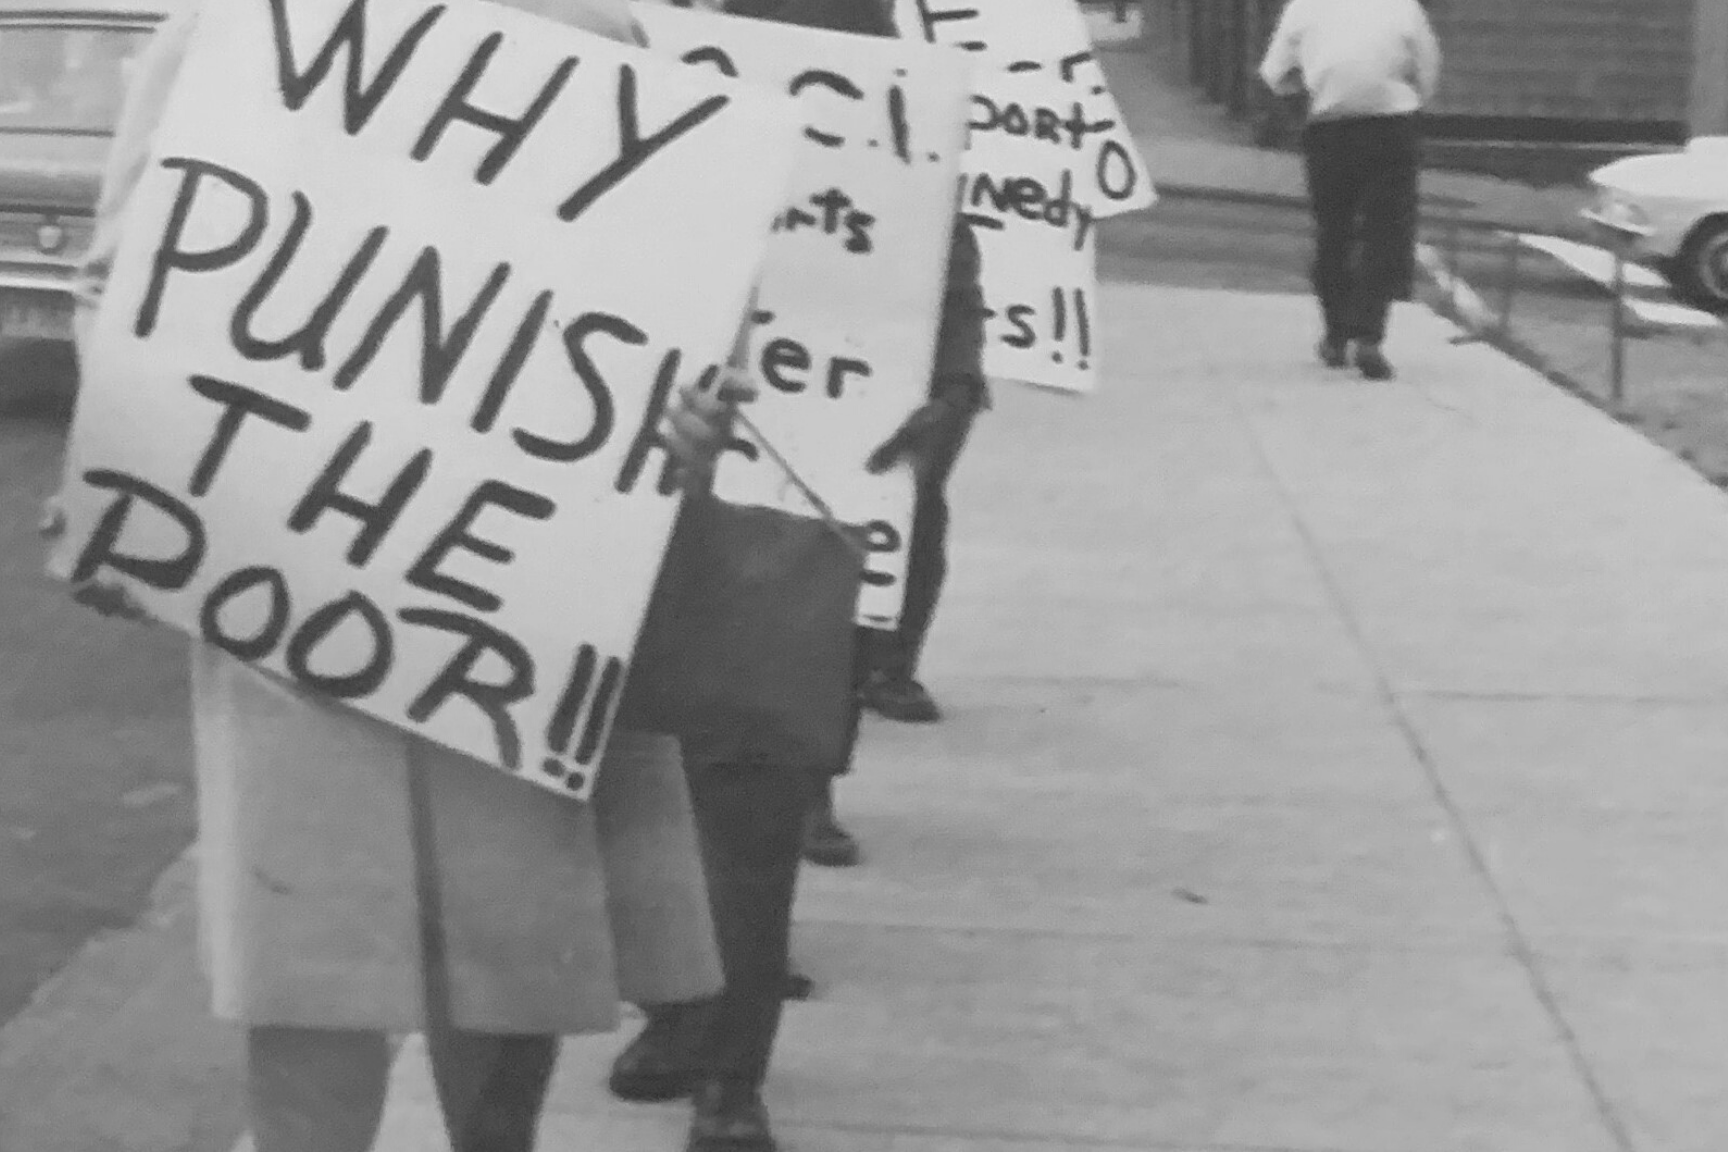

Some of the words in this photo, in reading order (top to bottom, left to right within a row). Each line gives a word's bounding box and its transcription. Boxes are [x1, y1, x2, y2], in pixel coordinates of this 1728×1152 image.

[134, 156, 719, 497] PUNISH
[750, 310, 871, 398] er
[984, 286, 1091, 371] s!!
[188, 374, 557, 613] THE
[73, 469, 623, 791] POOR!!
